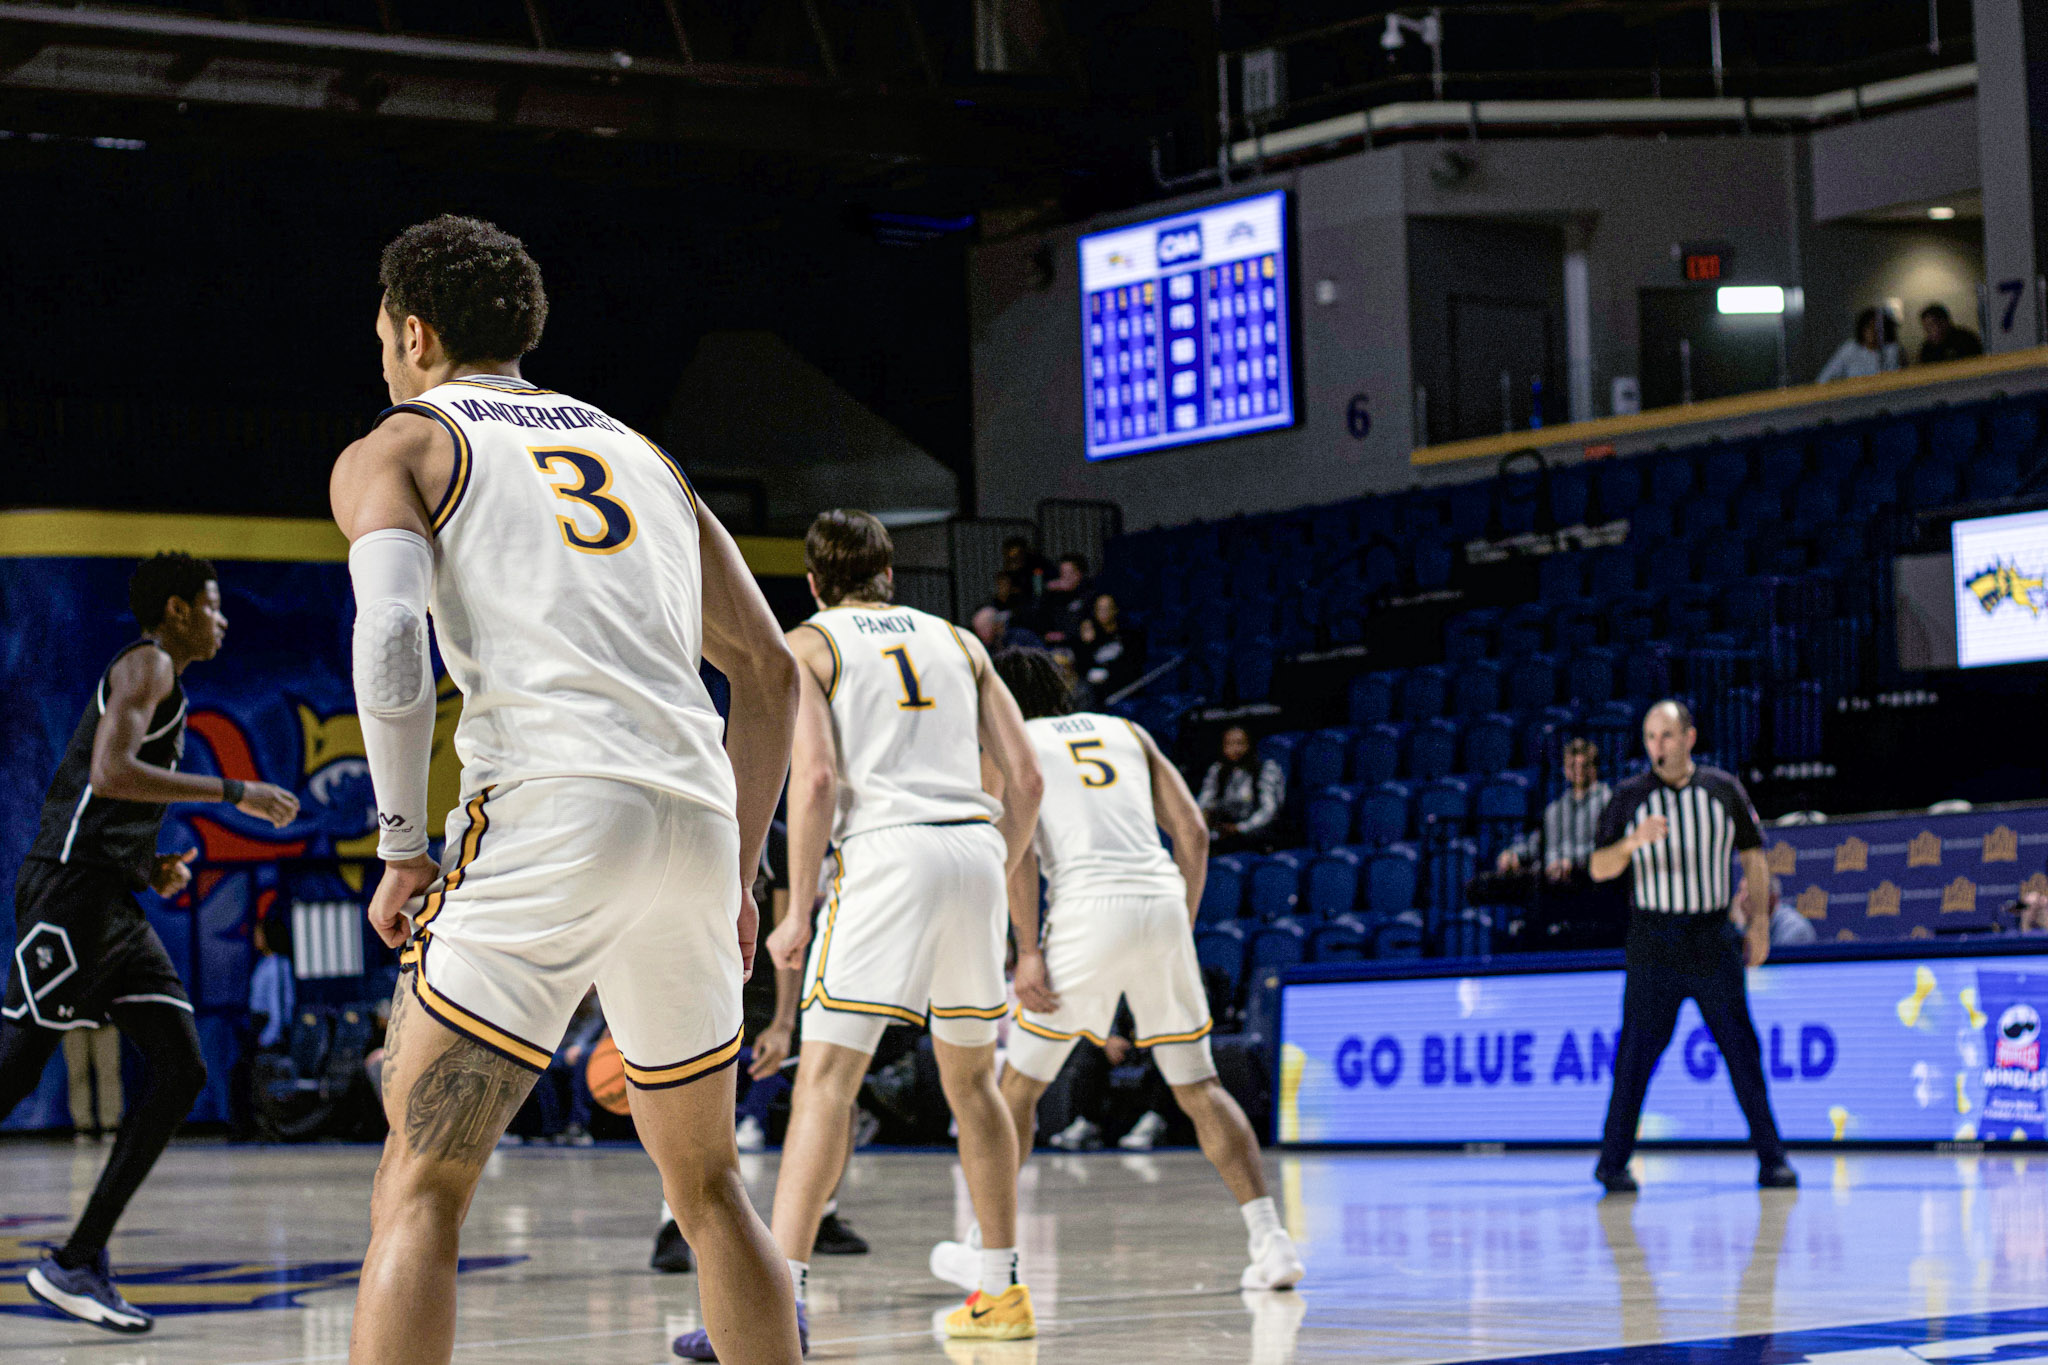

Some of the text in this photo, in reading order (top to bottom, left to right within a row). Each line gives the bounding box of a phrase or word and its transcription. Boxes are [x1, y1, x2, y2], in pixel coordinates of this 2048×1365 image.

[1997, 279, 2024, 333] 7
[450, 399, 626, 435] VANDERHORST
[1347, 393, 1371, 440] 6
[526, 445, 638, 556] 3
[852, 614, 916, 634] PANOV
[880, 643, 936, 712] 1
[1064, 737, 1119, 789] 5
[1336, 1022, 1838, 1089] GO BLUE AN GLD
